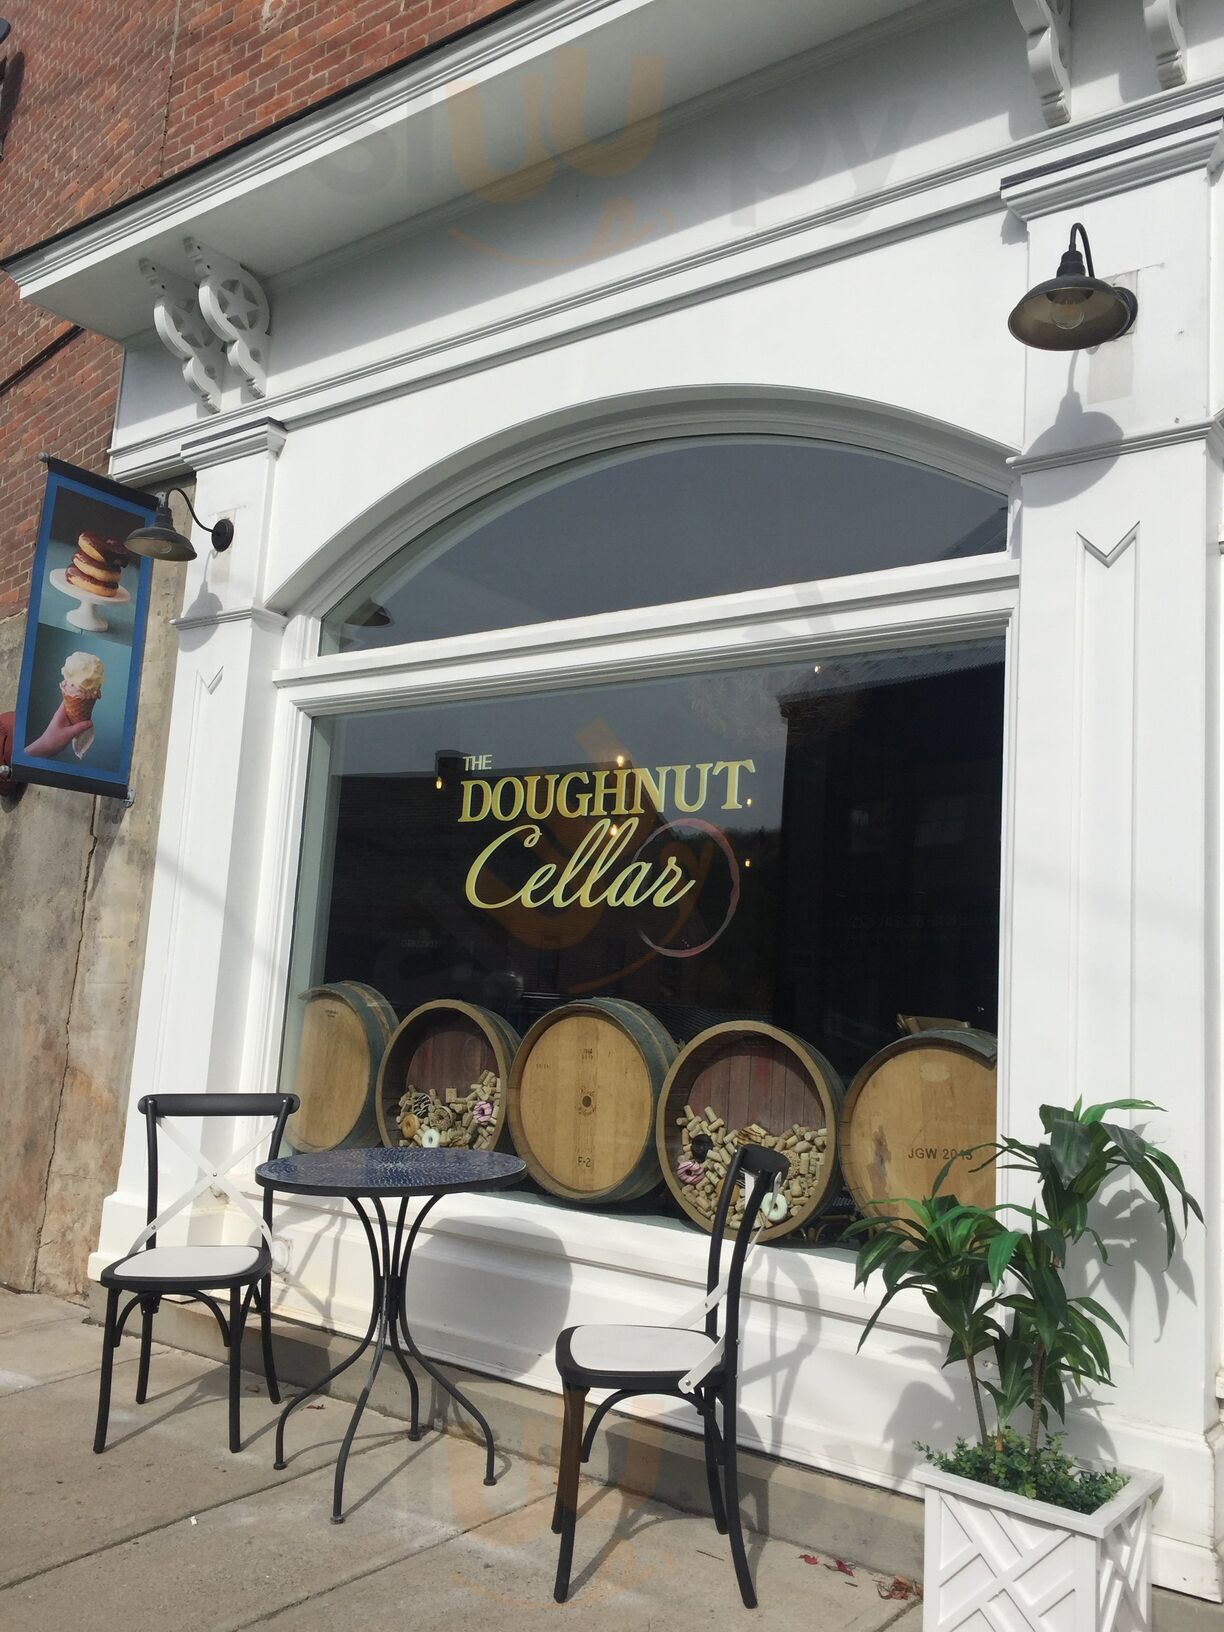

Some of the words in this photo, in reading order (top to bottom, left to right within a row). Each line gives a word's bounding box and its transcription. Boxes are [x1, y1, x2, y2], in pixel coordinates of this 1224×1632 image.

[462, 754, 493, 772] THE
[457, 759, 756, 823] DOUGHNUT
[465, 817, 697, 909] Cellar
[577, 1156, 592, 1168] F-2
[908, 1148, 938, 1160] JGW
